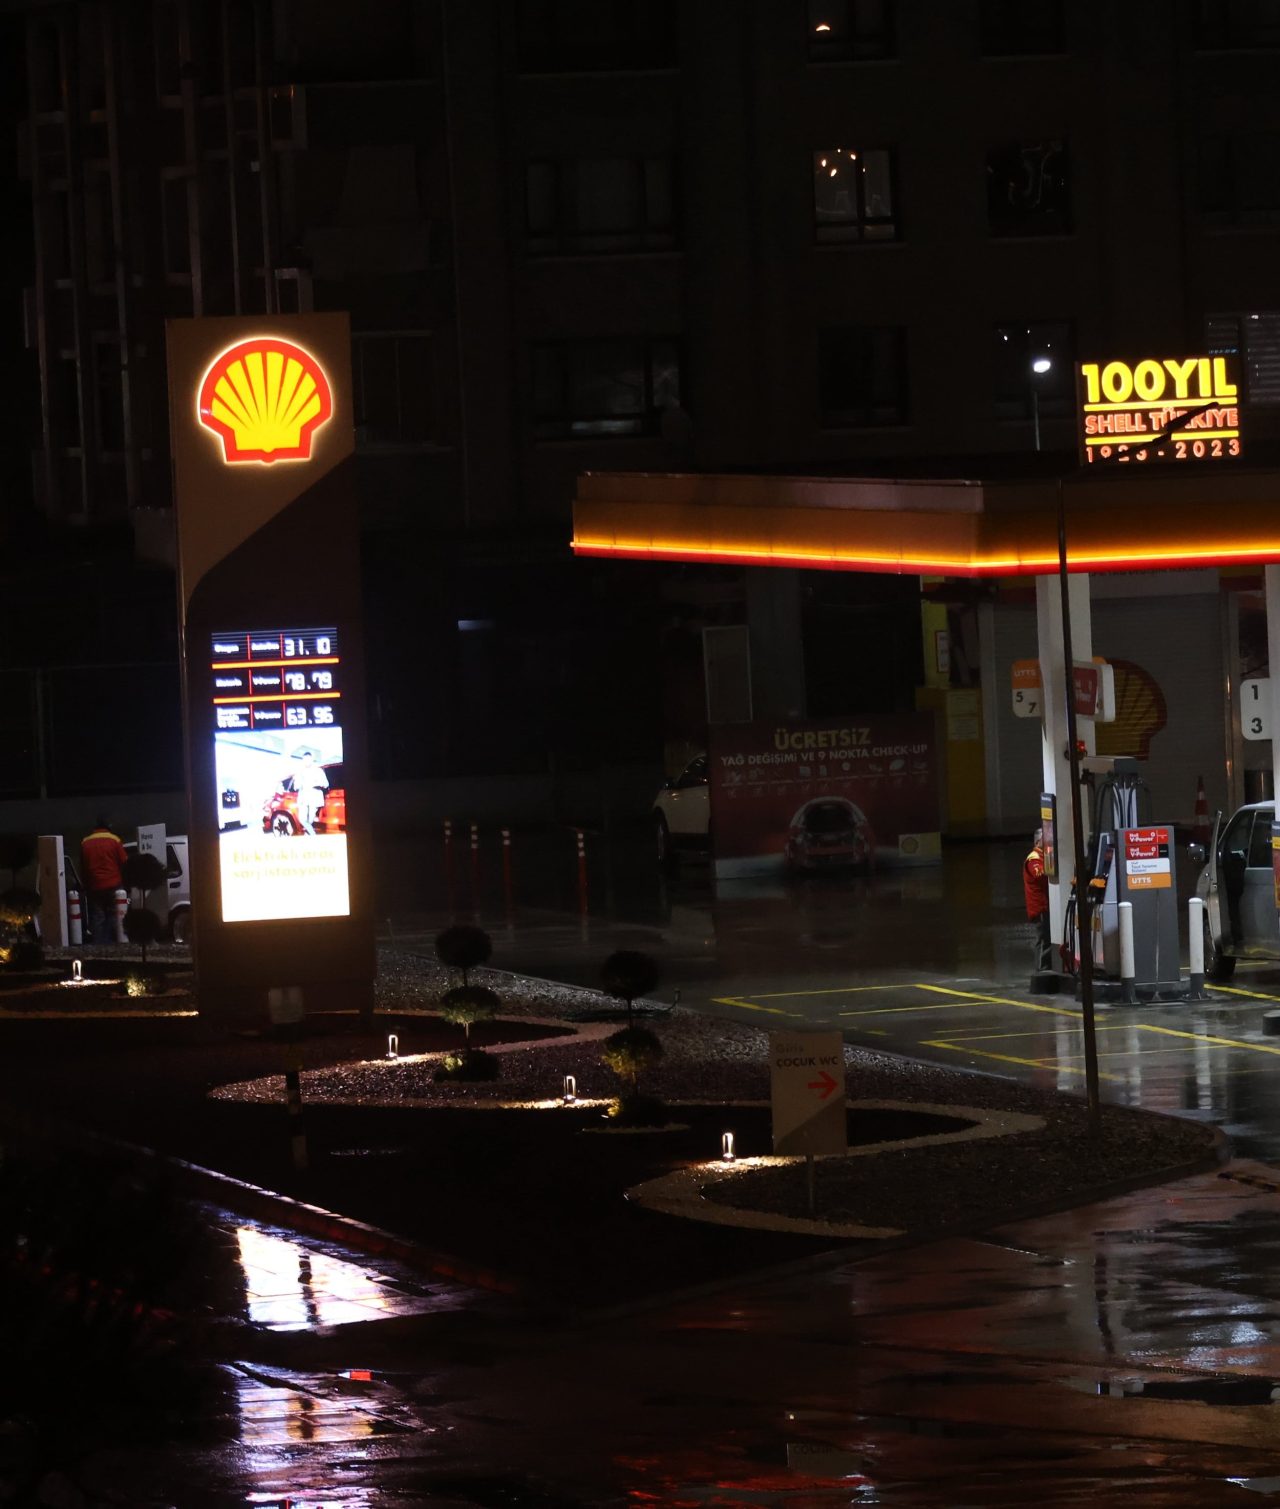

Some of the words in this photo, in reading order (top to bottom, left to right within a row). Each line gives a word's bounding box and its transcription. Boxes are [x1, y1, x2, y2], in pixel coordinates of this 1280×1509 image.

[1085, 413, 1147, 435] SHELL
[1175, 439, 1240, 459] 2023
[1015, 691, 1024, 702] 5
[1251, 684, 1259, 700] 1
[1028, 702, 1037, 713] 7
[1250, 717, 1263, 734] 3
[720, 754, 745, 766] YAĞ
[801, 751, 815, 762] VE
[818, 751, 825, 760] 9
[829, 748, 869, 760] NOKTA
[872, 743, 928, 757] CHECK-UP
[1131, 876, 1152, 885] UTTS
[776, 1056, 816, 1069] ÇOCUK
[819, 1055, 839, 1066] WC
